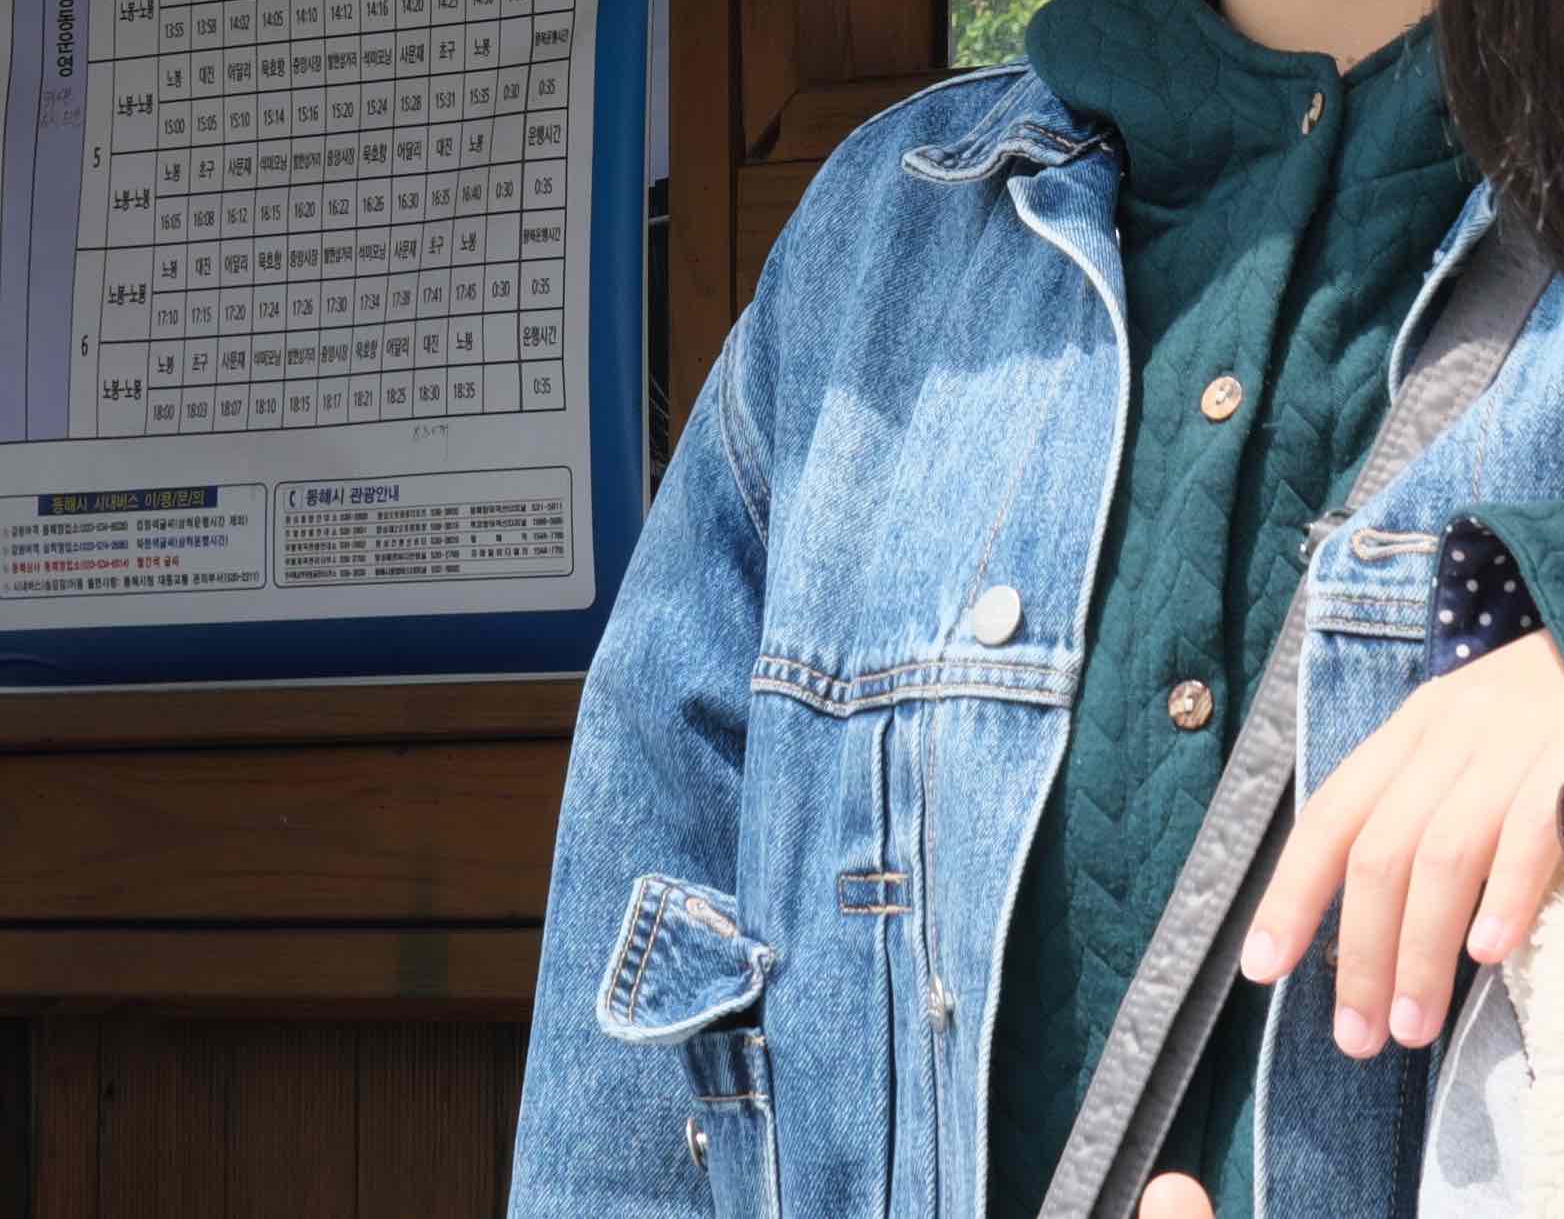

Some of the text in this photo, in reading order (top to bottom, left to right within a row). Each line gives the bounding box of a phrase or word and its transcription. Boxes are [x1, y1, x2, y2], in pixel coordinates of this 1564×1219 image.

[93, 147, 100, 168] 5
[80, 336, 89, 358] 6
[306, 485, 400, 506] 동해시 관광안내
